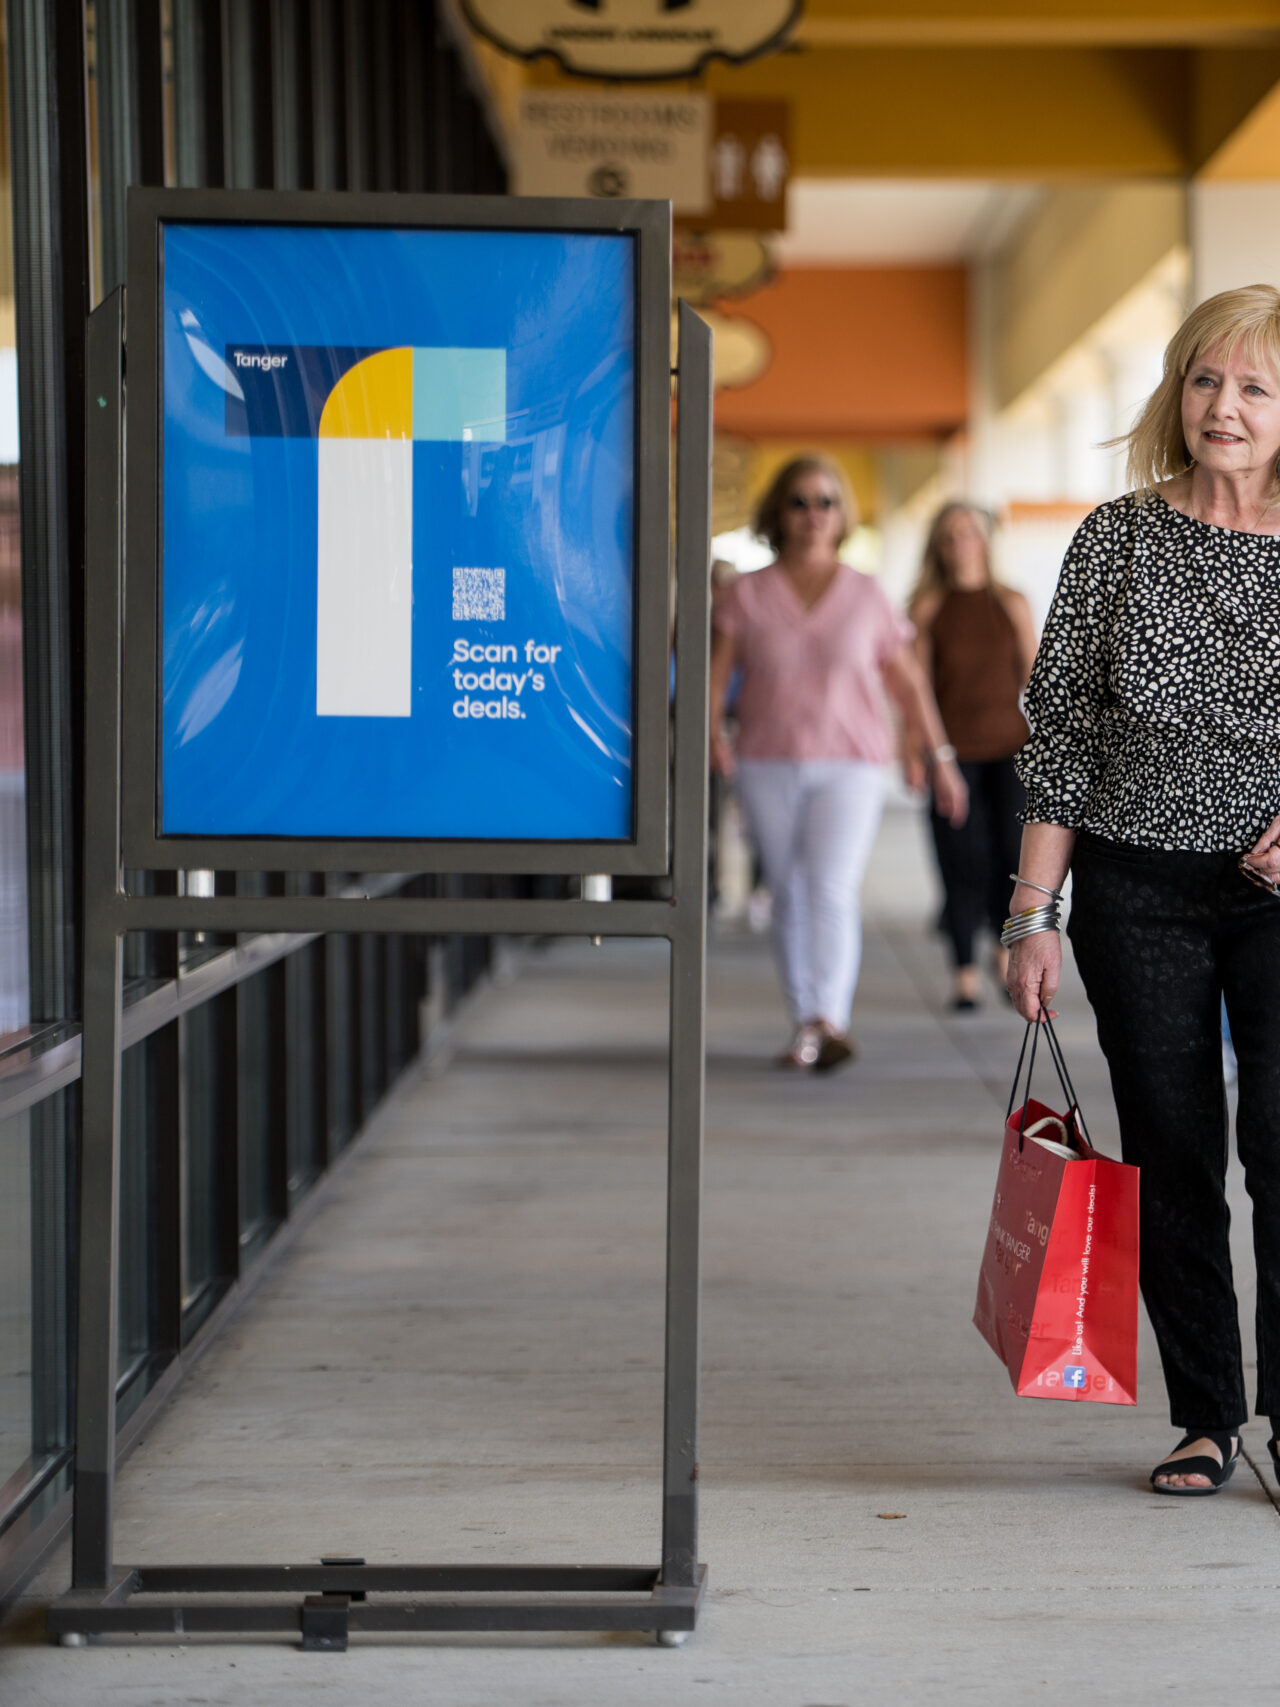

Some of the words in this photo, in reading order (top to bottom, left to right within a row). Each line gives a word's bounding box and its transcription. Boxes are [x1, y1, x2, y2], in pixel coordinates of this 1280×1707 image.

[234, 352, 288, 372] Tanger
[452, 638, 518, 663] Scan
[524, 638, 562, 663] for
[452, 667, 546, 696] today's
[452, 695, 527, 719] deals.
[1087, 1184, 1097, 1214] deals!
[1086, 1216, 1094, 1232] our
[1082, 1234, 1093, 1255] love
[1080, 1257, 1090, 1275] will
[1080, 1276, 1089, 1295] you
[1076, 1297, 1087, 1318] And
[1074, 1320, 1084, 1336] us!
[1072, 1335, 1084, 1356] Like
[1034, 1366, 1115, 1395] Tager
